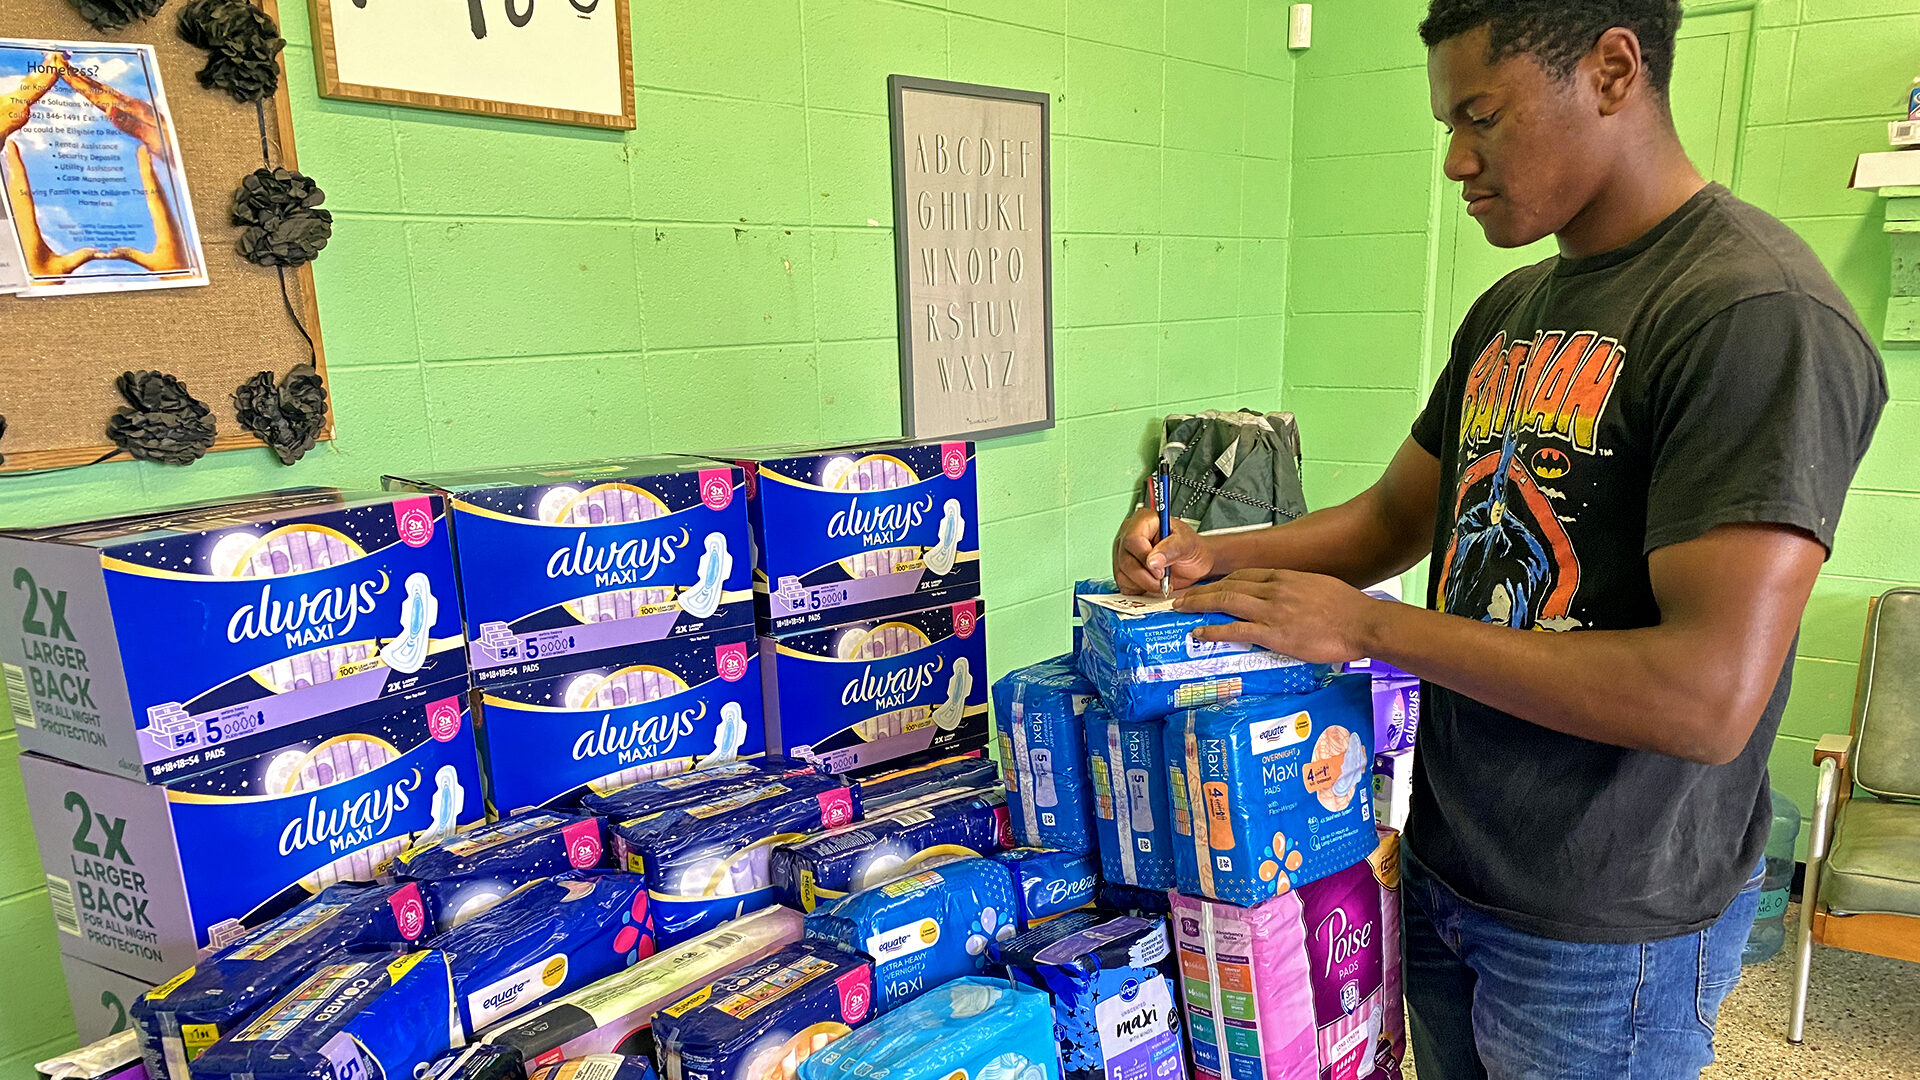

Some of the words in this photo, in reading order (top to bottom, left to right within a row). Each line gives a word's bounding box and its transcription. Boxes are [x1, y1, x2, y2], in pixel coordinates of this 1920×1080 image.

[27, 61, 100, 77] Homeless?
[48, 98, 82, 107] Solutions
[34, 126, 54, 134] could
[55, 126, 65, 134] be
[55, 141, 79, 149] Rental
[81, 142, 118, 150] Assistance
[58, 152, 88, 161] Security
[90, 153, 121, 162] Deposits
[60, 164, 84, 173] Utility
[82, 175, 127, 184] Management
[937, 351, 1016, 392] WXYZ
[1459, 329, 1627, 456] BATMAN
[827, 496, 924, 542] always
[862, 531, 894, 547] MAXI
[546, 531, 677, 582] always
[594, 569, 638, 588] MAXI
[792, 598, 805, 609] 54
[811, 590, 821, 609] 5
[227, 583, 378, 644] always
[285, 623, 335, 650] MAXI
[1145, 634, 1178, 642] OVERNIGHT
[1146, 640, 1181, 655] Maxi
[21, 638, 89, 672] LARGER
[500, 647, 517, 659] 54
[526, 637, 539, 659] 5
[522, 663, 540, 673] PADS
[29, 665, 97, 710] BACK
[841, 664, 935, 706] always
[875, 693, 905, 711] MAXI
[36, 701, 54, 717] FOR
[55, 706, 70, 721] ALL
[71, 709, 101, 728] NIGHT
[1404, 690, 1420, 743] always
[41, 718, 108, 748] PROTECTION
[175, 731, 196, 747] 54
[205, 717, 222, 743] 5
[572, 713, 696, 761] always
[1032, 713, 1043, 743] Maxi
[1260, 725, 1286, 740] equate
[204, 747, 226, 761] PADS
[618, 745, 658, 765] MAXI
[1128, 731, 1140, 763] Maxi
[1206, 739, 1220, 777] Maxi
[1262, 748, 1297, 764] OVERNIGHT
[1262, 757, 1298, 786] Maxi
[1307, 768, 1314, 781] 4
[1211, 788, 1223, 798] 4
[1264, 785, 1281, 796] PADS
[278, 795, 410, 856] always
[329, 828, 373, 854] MAXI
[71, 854, 148, 894] LARGER
[1223, 859, 1230, 869] 26
[1046, 873, 1098, 905] Breeze
[77, 880, 155, 928] BACK
[83, 913, 103, 928] FOR
[105, 917, 122, 933] ALL
[126, 924, 158, 944] NIGHT
[87, 929, 163, 962] PROTECTION
[879, 936, 907, 952] equate
[1315, 907, 1372, 978] Poise
[882, 960, 903, 974] EXTRA
[904, 952, 927, 965] HEAVY
[884, 963, 921, 982] OVERNIGHT
[1339, 960, 1359, 980] PADS
[726, 963, 779, 991] COMBO
[885, 971, 923, 1003] Maxi
[314, 978, 369, 1021] COMBO
[483, 981, 525, 1009] equate
[1121, 1001, 1147, 1017] UNSCENTED
[1116, 1004, 1158, 1038] maxi
[1113, 1065, 1122, 1080] 5
